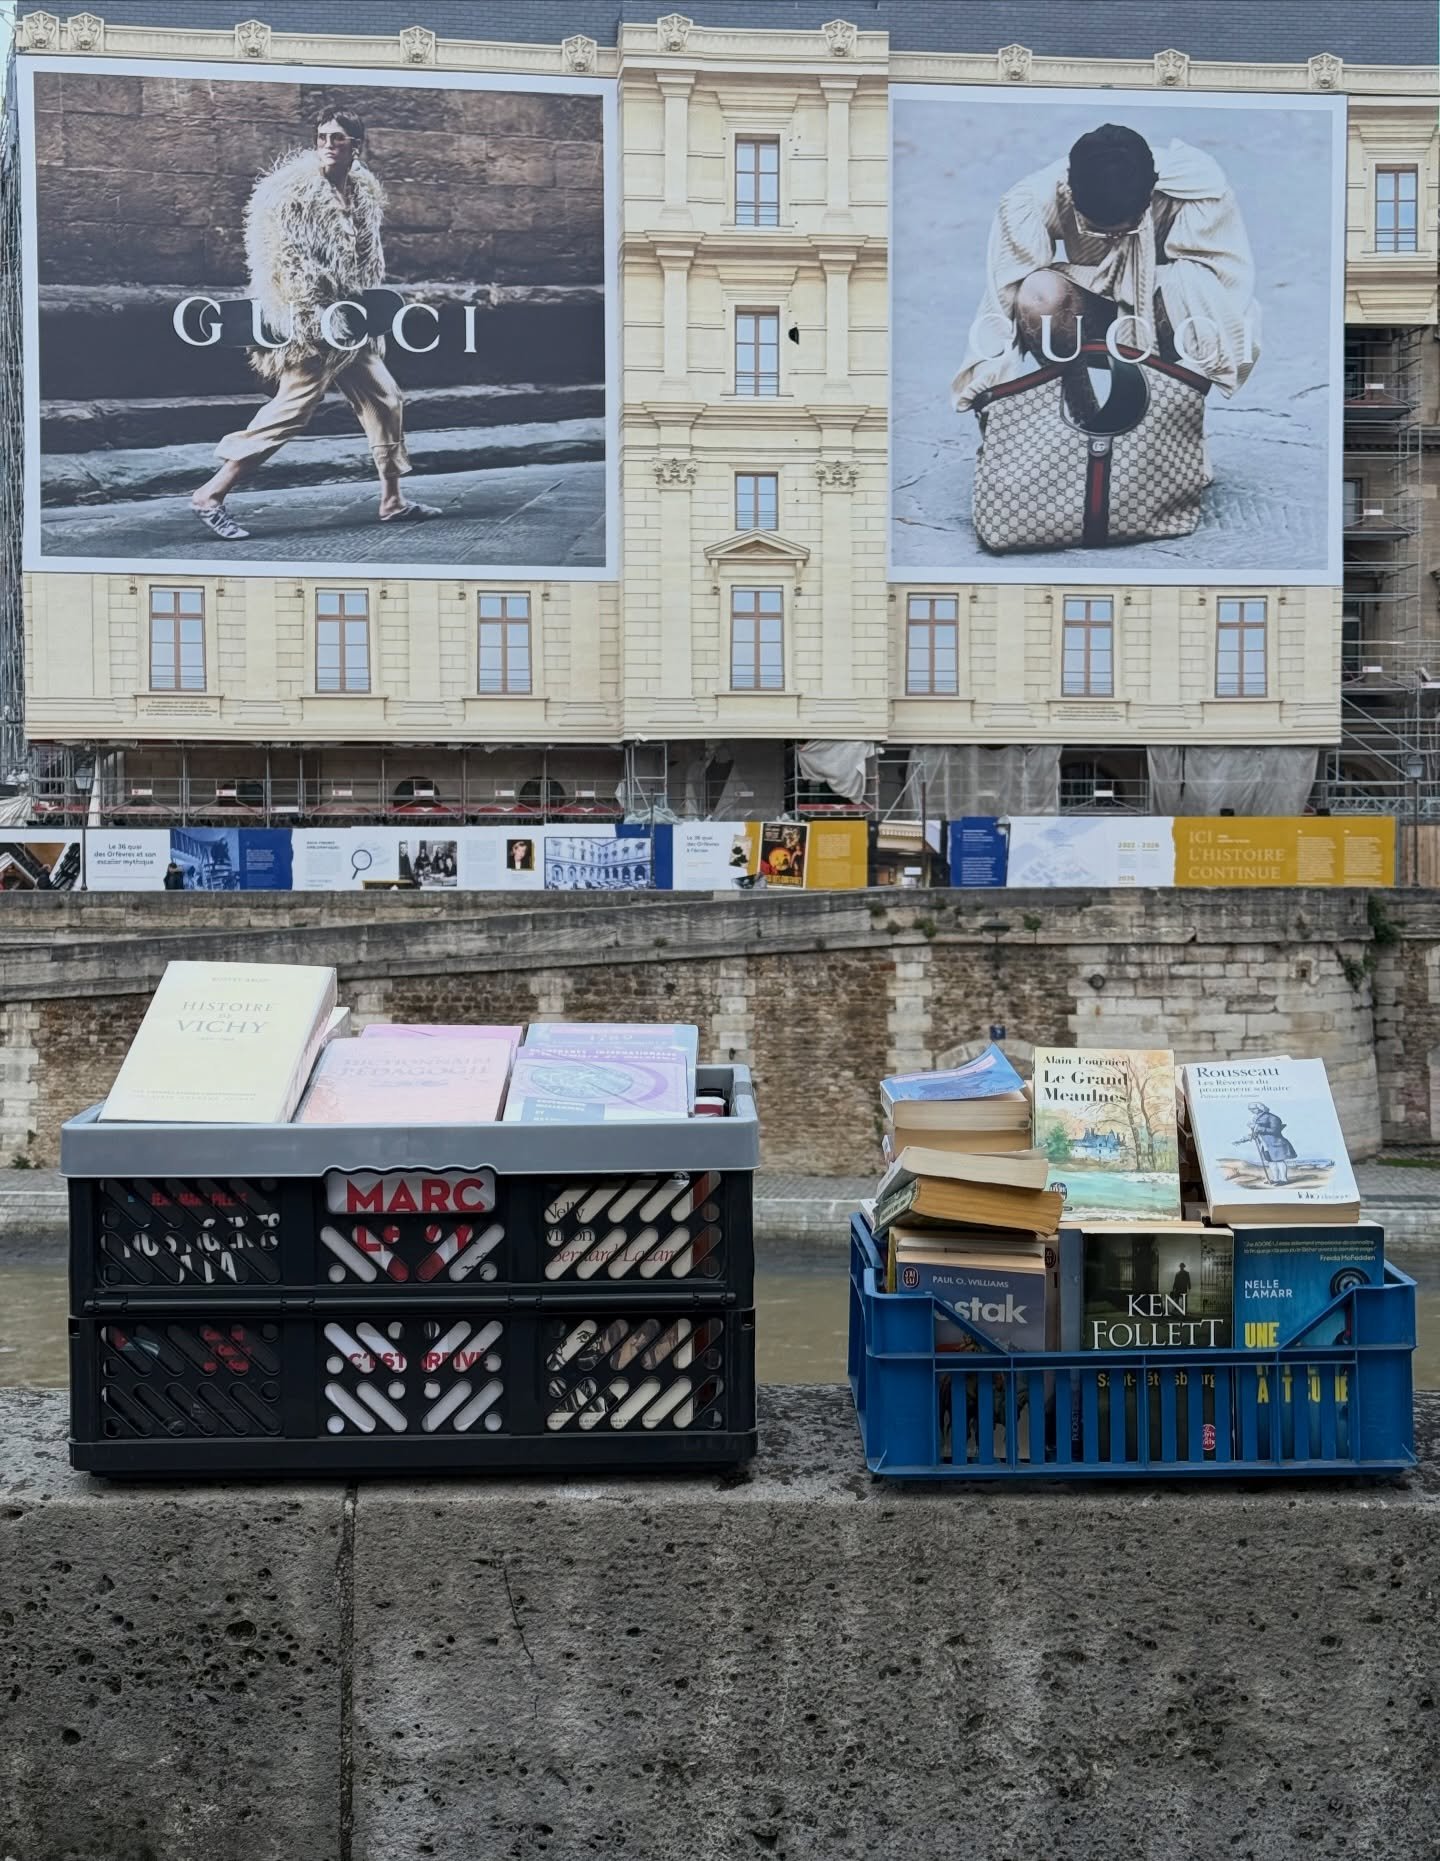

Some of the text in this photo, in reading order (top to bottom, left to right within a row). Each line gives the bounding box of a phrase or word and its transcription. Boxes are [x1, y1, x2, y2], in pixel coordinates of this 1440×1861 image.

[172, 295, 478, 354] GUCCI
[968, 312, 1256, 365] GUCCI
[1189, 831, 1213, 844] ICI
[1189, 848, 1286, 862] L'HISTOIRE
[1189, 866, 1281, 879] CONTINUE
[182, 1001, 274, 1012] HISTOIRE
[176, 1019, 271, 1034] VICHY
[1044, 1070, 1128, 1086] Le Grand
[1196, 1066, 1280, 1079] Rousseau
[1042, 1087, 1127, 1103] Meaulnes
[346, 1177, 485, 1213] MARC
[546, 1202, 585, 1223] Nelly
[932, 1275, 1009, 1289] PAUL O. WILLIAMS
[1244, 1280, 1279, 1289] NELLE
[1244, 1289, 1293, 1299] LAMARR
[1126, 1293, 1187, 1317] KEN
[1091, 1318, 1225, 1350] FOLLETT
[1244, 1321, 1280, 1349] UNE
